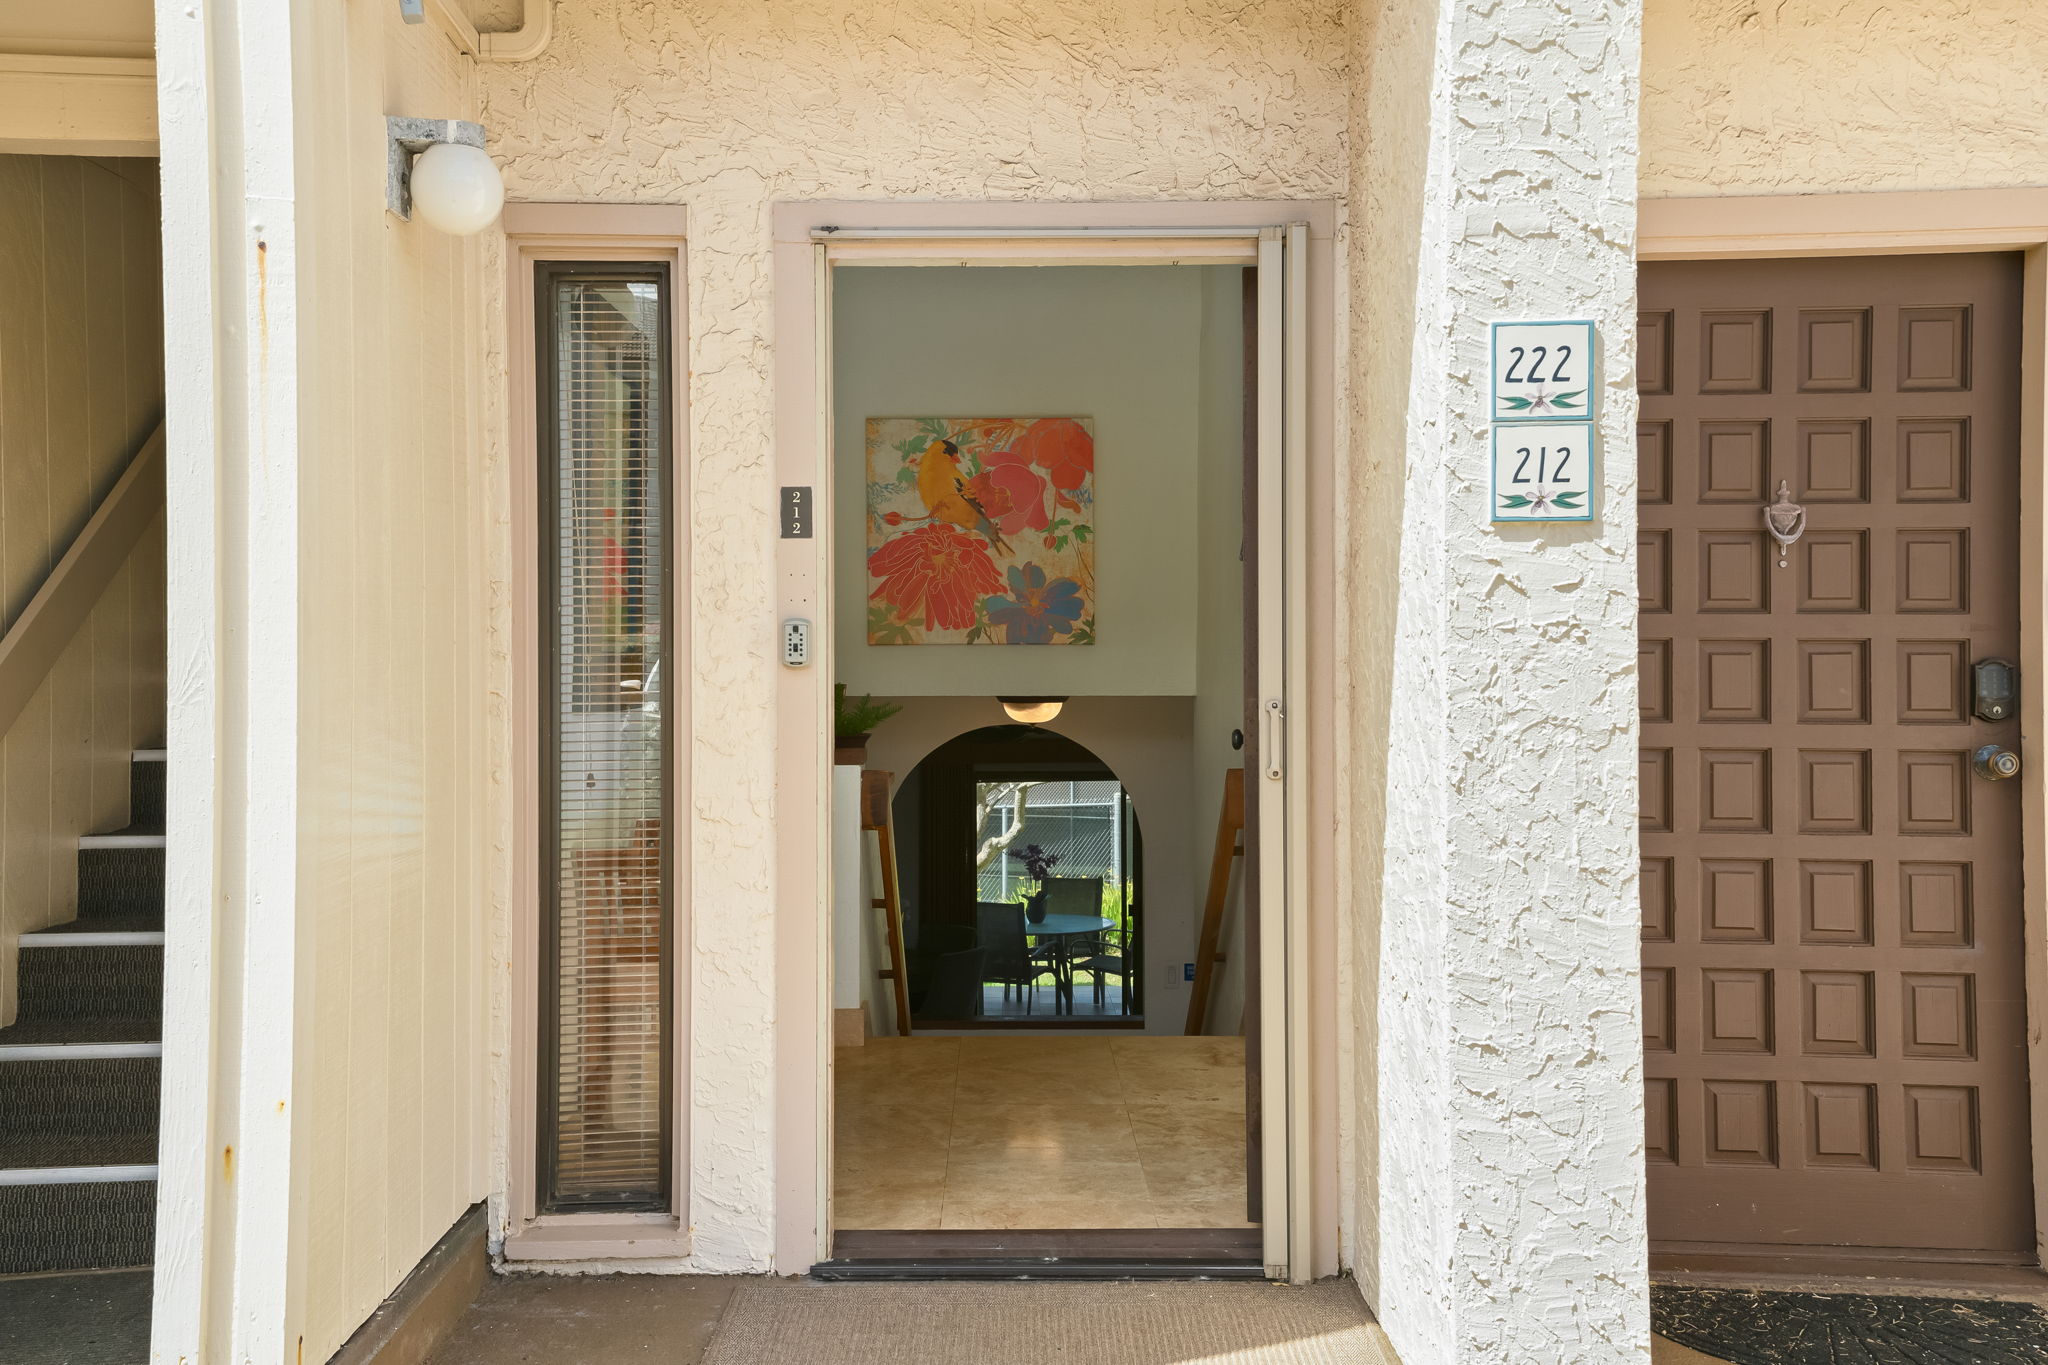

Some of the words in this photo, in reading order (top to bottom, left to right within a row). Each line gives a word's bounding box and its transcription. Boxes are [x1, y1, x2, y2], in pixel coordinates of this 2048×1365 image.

[1504, 345, 1572, 383] 222
[1512, 446, 1571, 484] 212
[792, 491, 801, 534] 212
